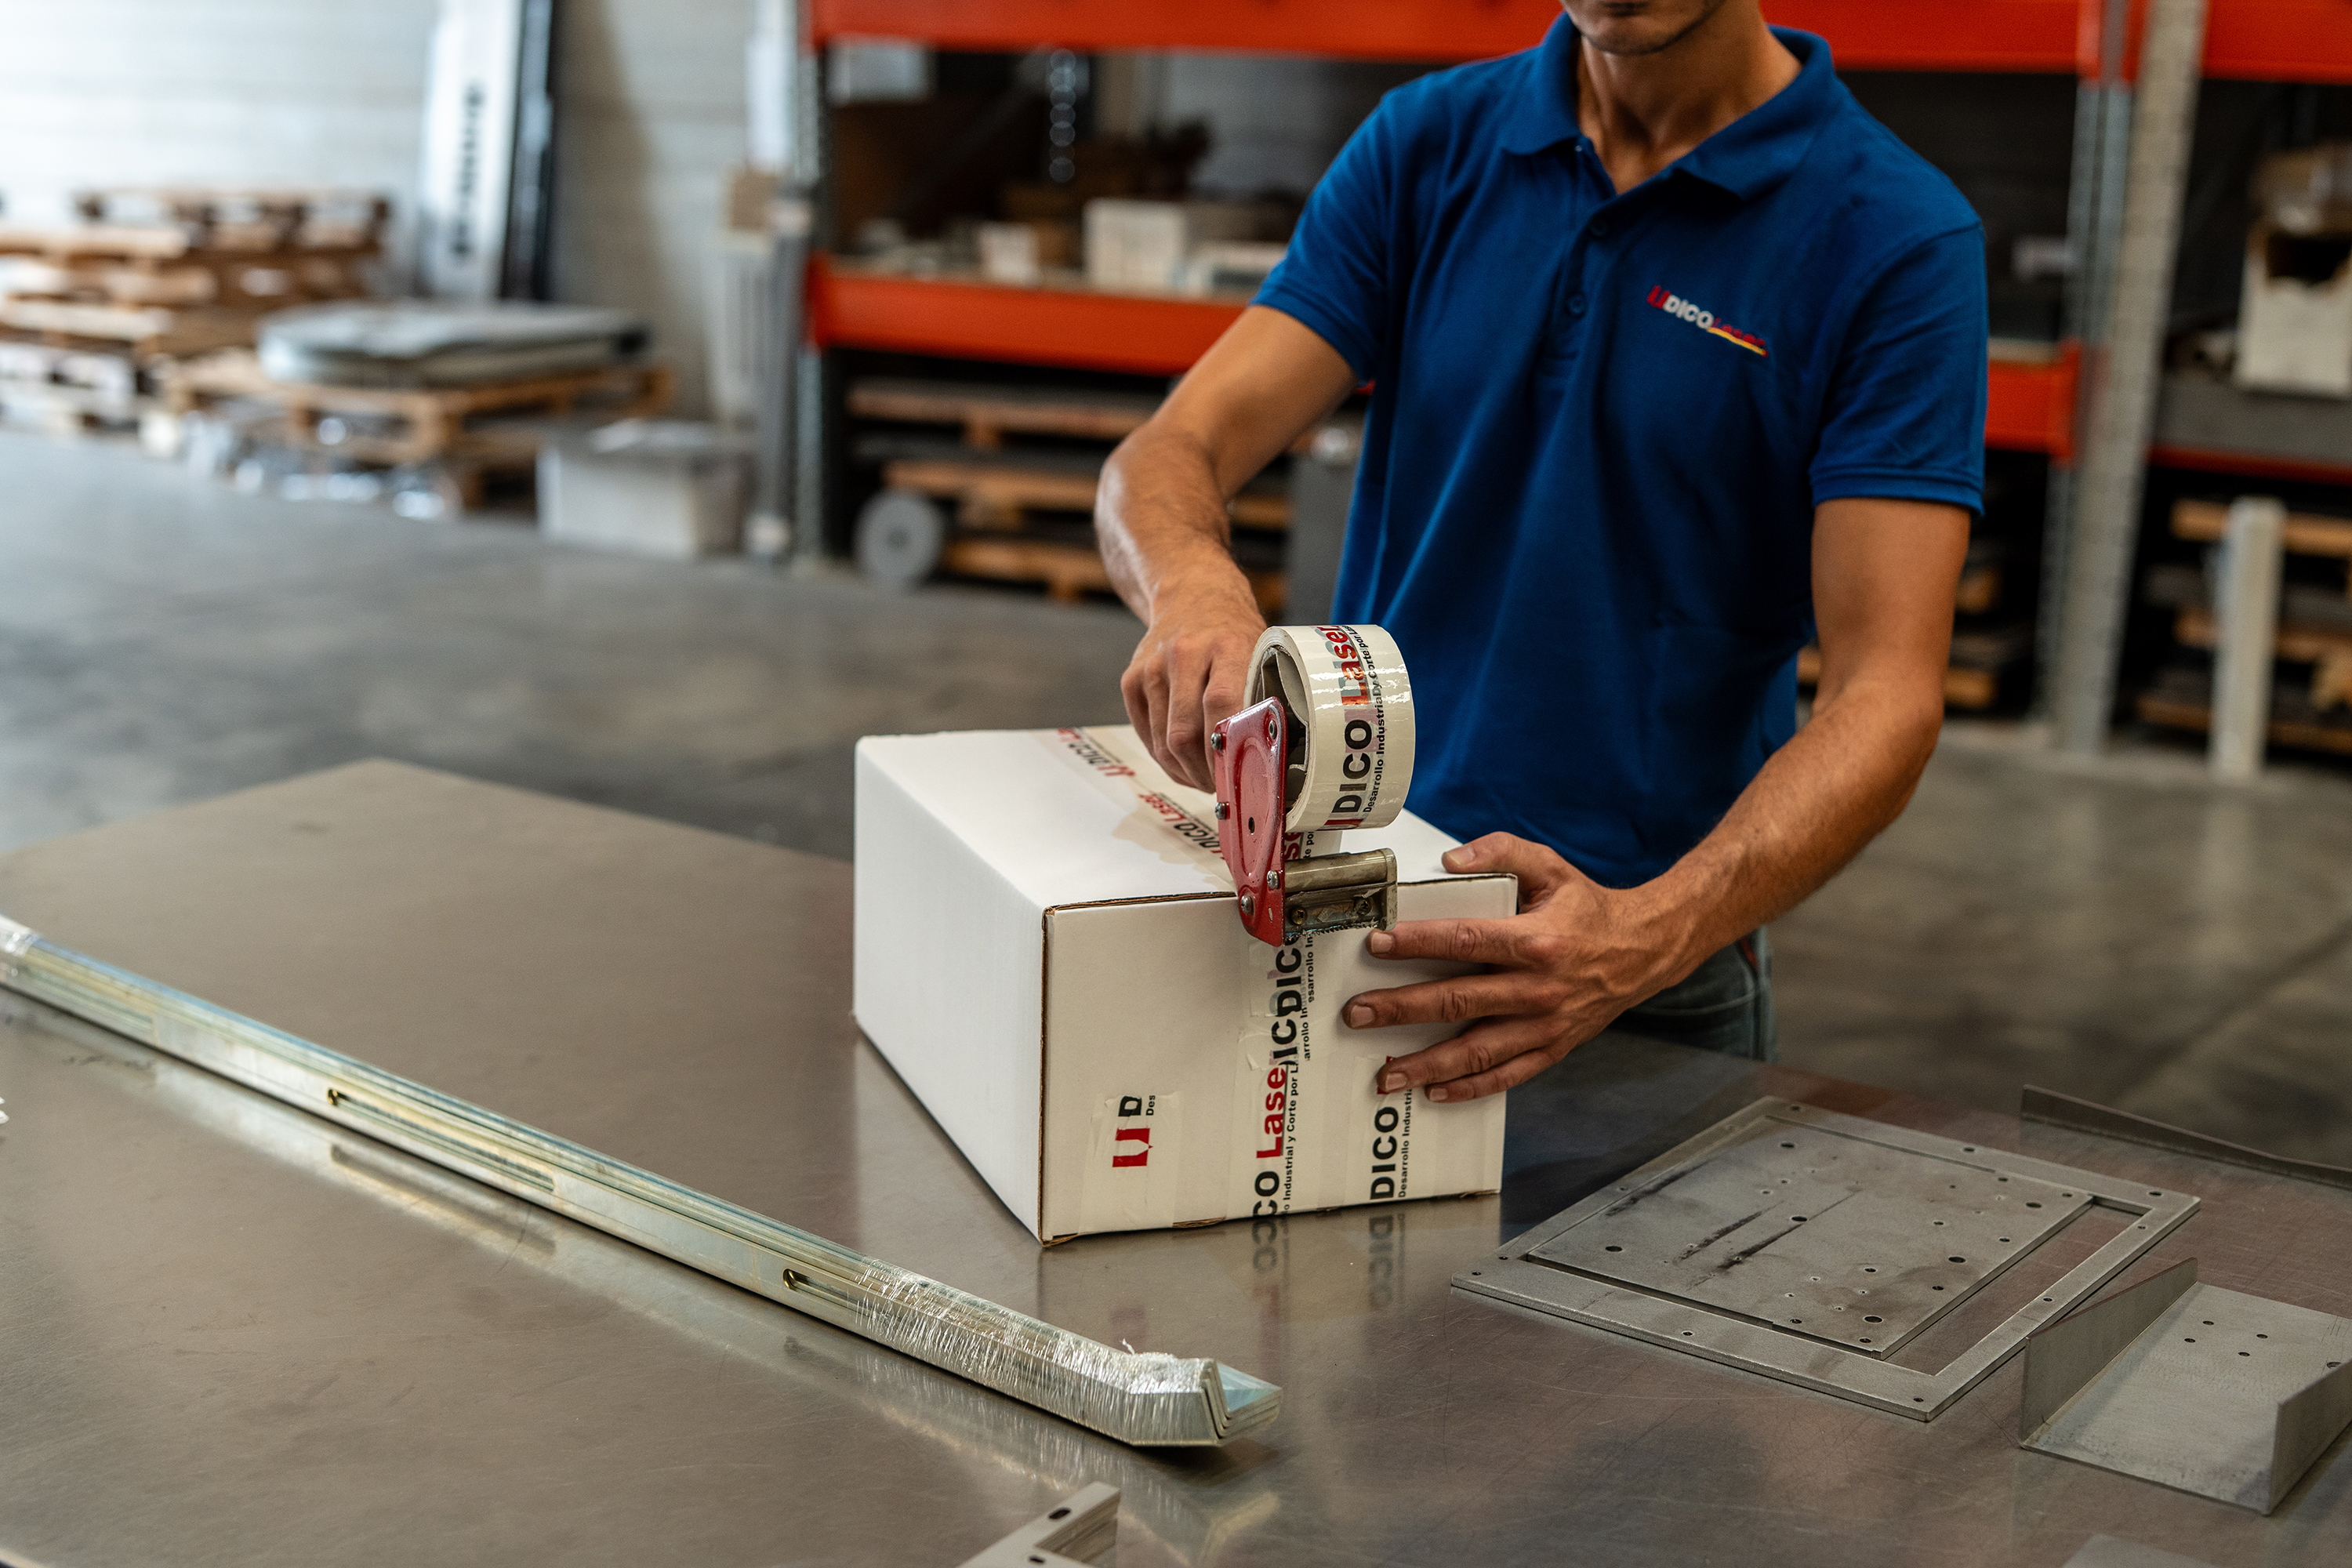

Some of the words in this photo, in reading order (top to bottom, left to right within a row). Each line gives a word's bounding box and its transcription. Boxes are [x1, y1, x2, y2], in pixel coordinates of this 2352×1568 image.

[1646, 285, 1715, 329] UDICO
[1316, 625, 1370, 705] Laser
[1353, 635, 1369, 648] por
[1363, 650, 1377, 679] Corte
[1363, 759, 1384, 812] Desarrollo
[1274, 932, 1302, 1017] DIC
[1145, 1094, 1156, 1116] Des
[1290, 1076, 1299, 1096] por
[1256, 1067, 1287, 1159] Lase
[1287, 1099, 1298, 1132] Corte
[1283, 1145, 1294, 1200] Industrial
[1398, 1140, 1410, 1199] Desarrollo
